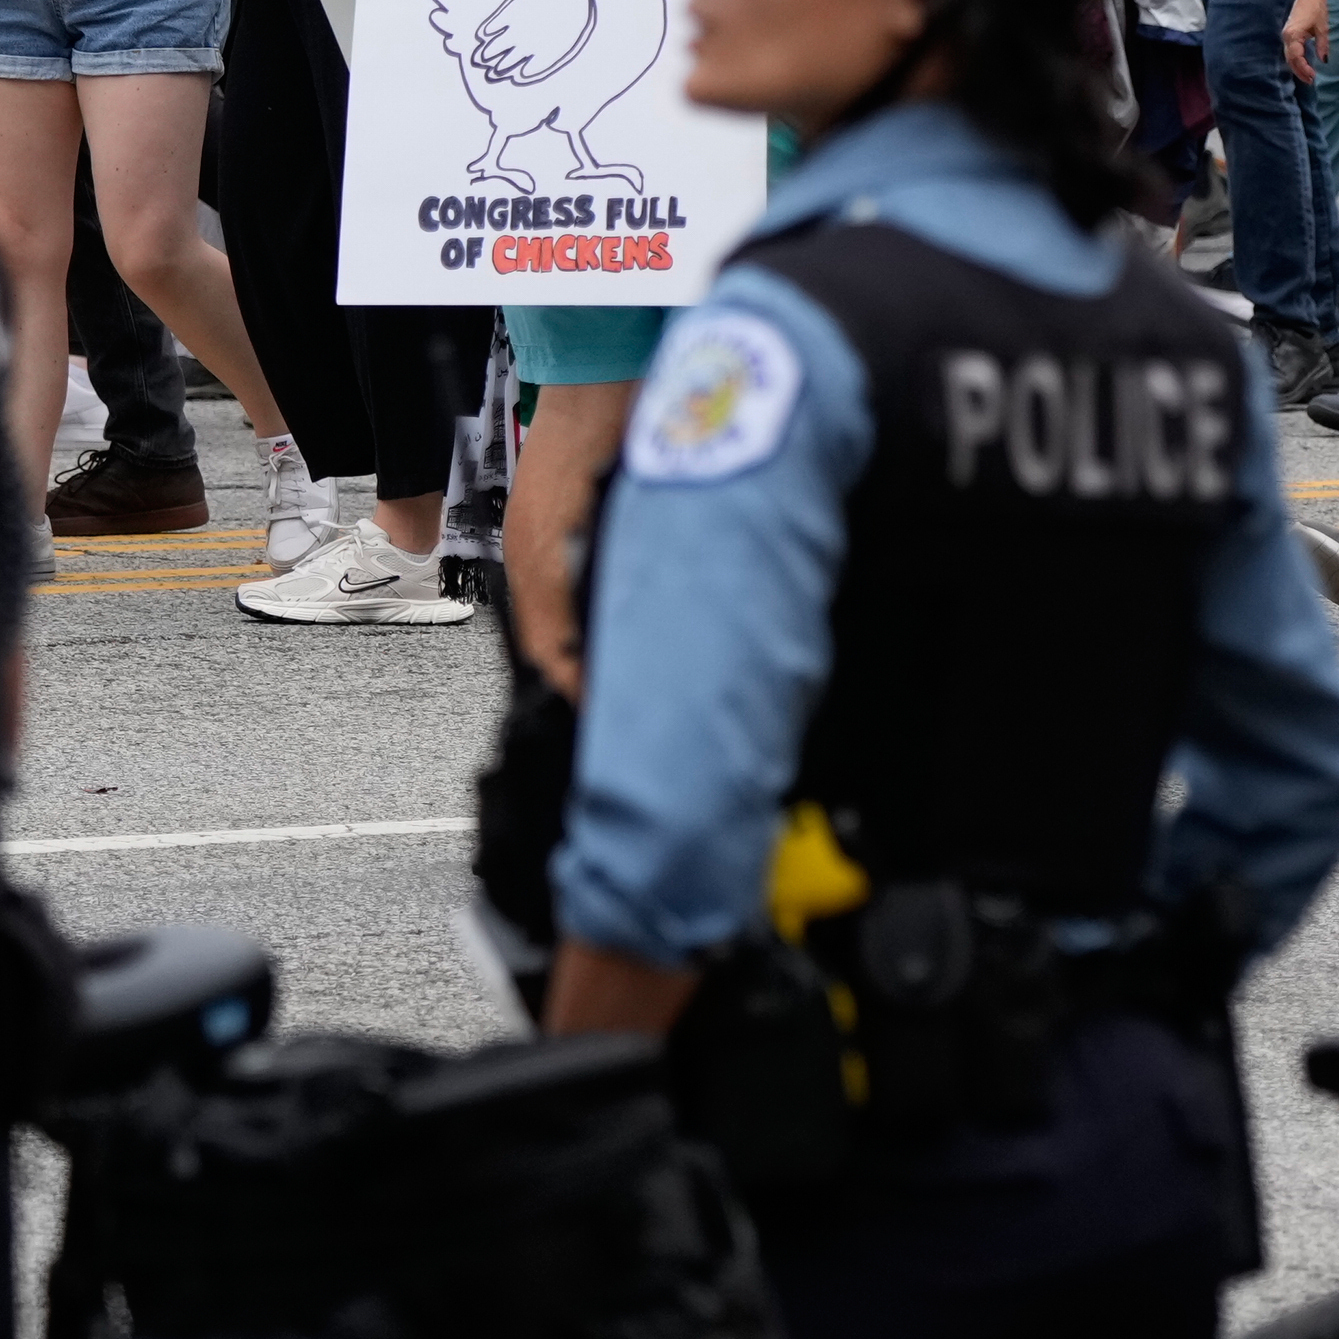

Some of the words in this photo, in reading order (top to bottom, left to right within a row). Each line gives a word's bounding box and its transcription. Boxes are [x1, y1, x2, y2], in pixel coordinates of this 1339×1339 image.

[418, 194, 596, 232] CONGRESS
[605, 196, 687, 231] FULL
[440, 236, 485, 270] OF
[491, 232, 674, 275] CHICKENS
[941, 349, 1237, 500] POLICE
